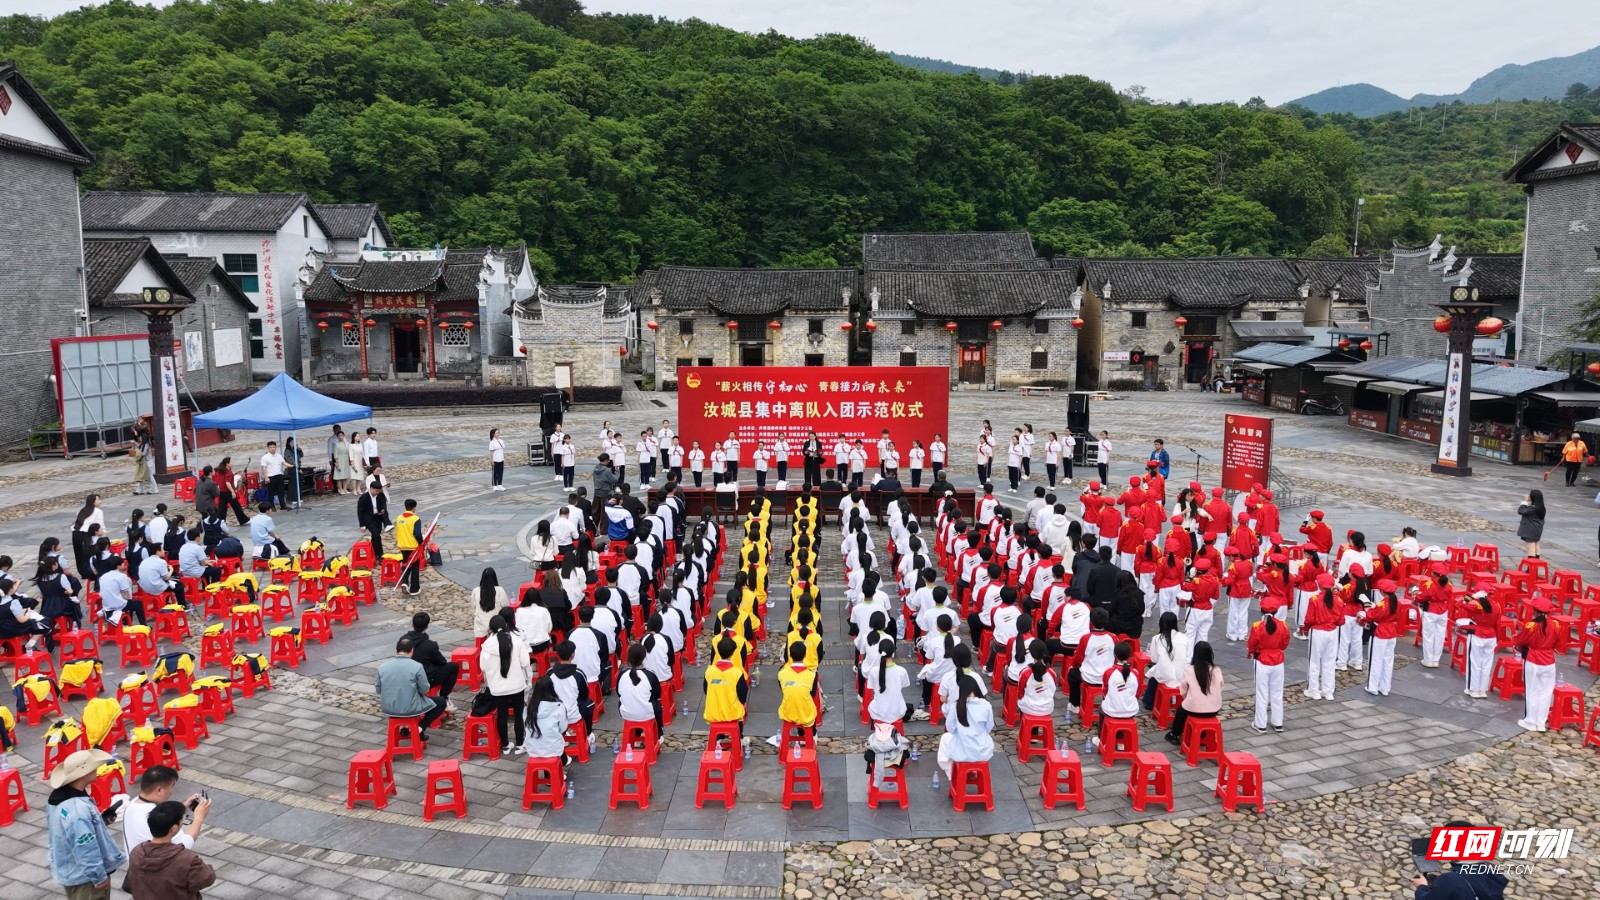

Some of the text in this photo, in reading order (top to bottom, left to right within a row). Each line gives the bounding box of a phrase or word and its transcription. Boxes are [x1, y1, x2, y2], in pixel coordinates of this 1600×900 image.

[703, 401, 924, 418] 汝城县集中离队入团示范仪式
